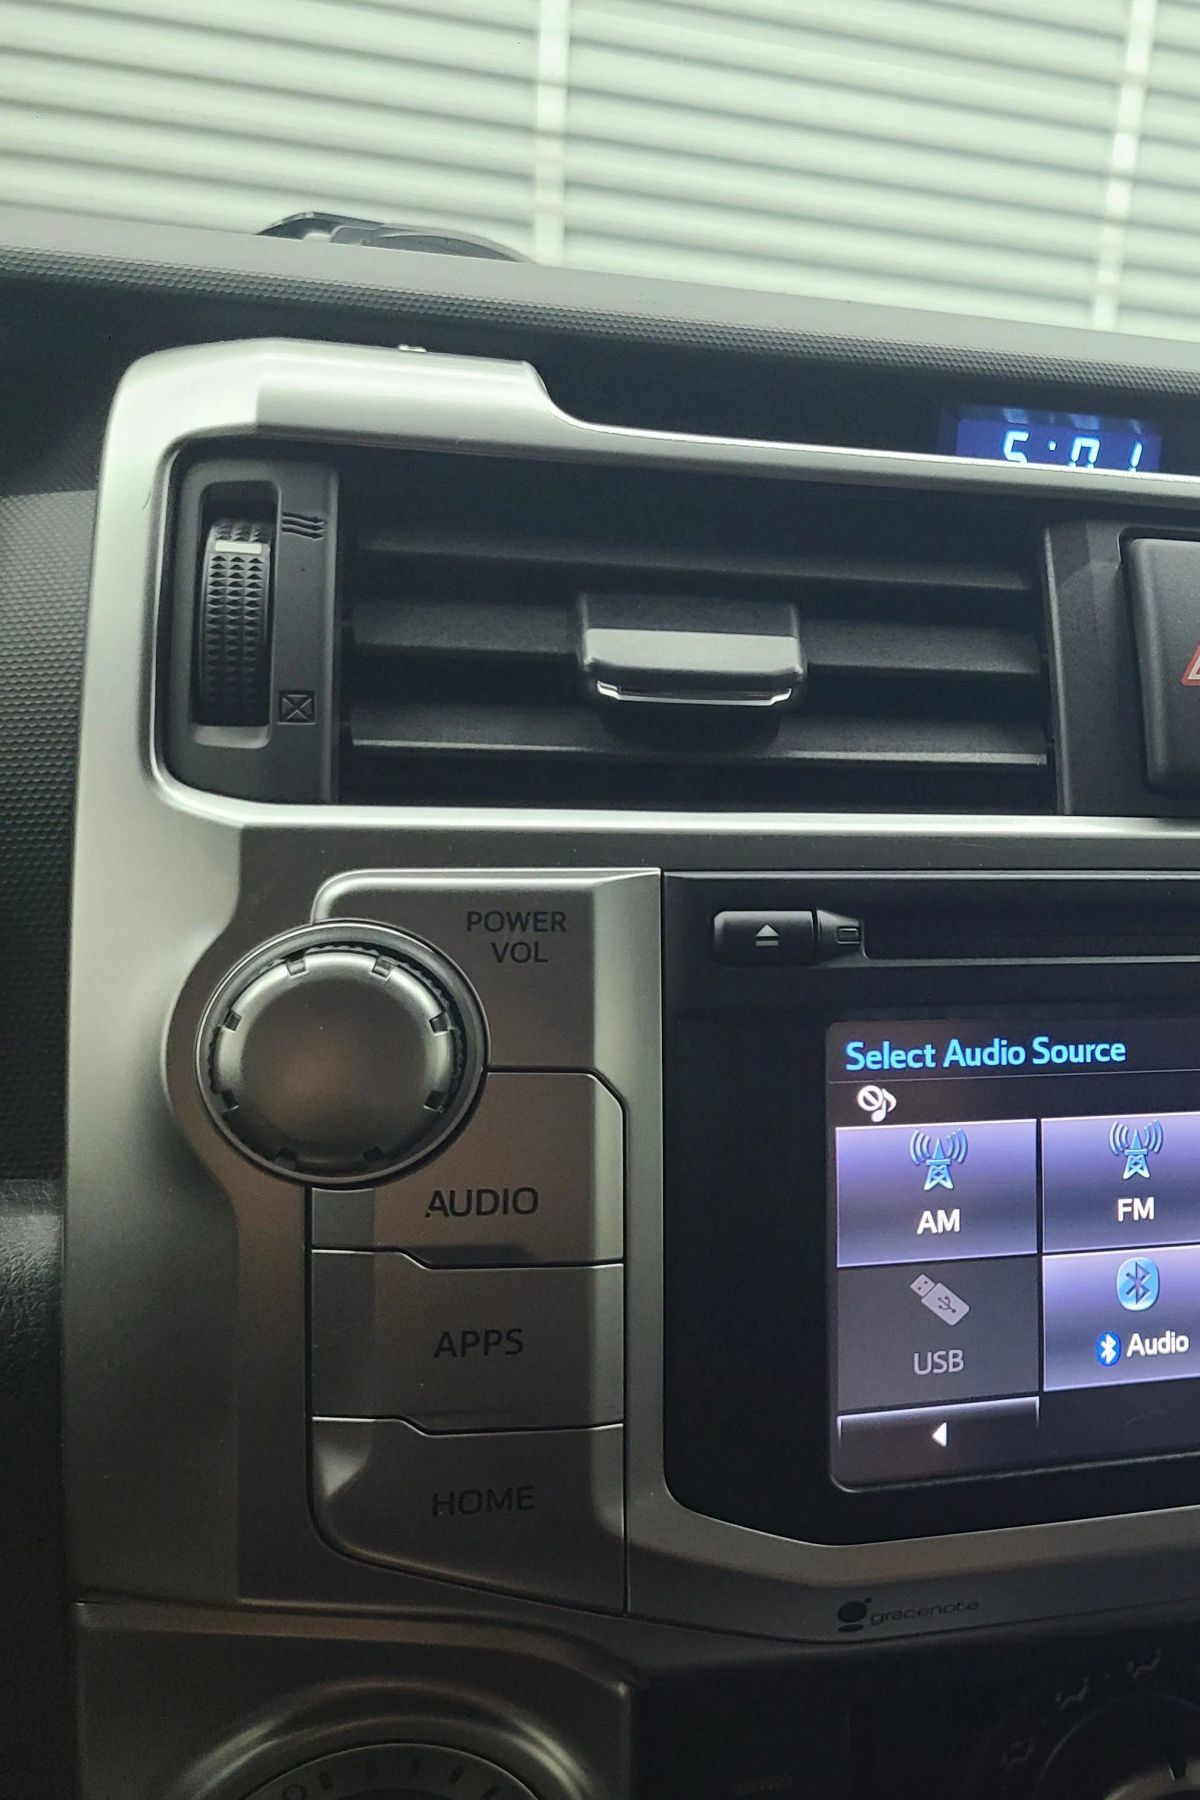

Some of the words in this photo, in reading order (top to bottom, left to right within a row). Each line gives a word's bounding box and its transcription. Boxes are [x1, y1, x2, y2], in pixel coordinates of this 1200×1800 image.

[466, 910, 567, 933] POWER
[491, 941, 548, 964] VOL
[845, 1040, 937, 1071] Select
[942, 1038, 1027, 1068] Audio
[1031, 1035, 1128, 1066] Source
[427, 1187, 539, 1217] AUDIO
[1116, 1197, 1156, 1223] FM
[916, 1209, 962, 1236] AM
[434, 1328, 524, 1358] APPS
[1126, 1331, 1190, 1356] Audio
[913, 1349, 965, 1376] USB
[432, 1486, 535, 1517] HOME
[870, 1602, 980, 1626] gracenote
